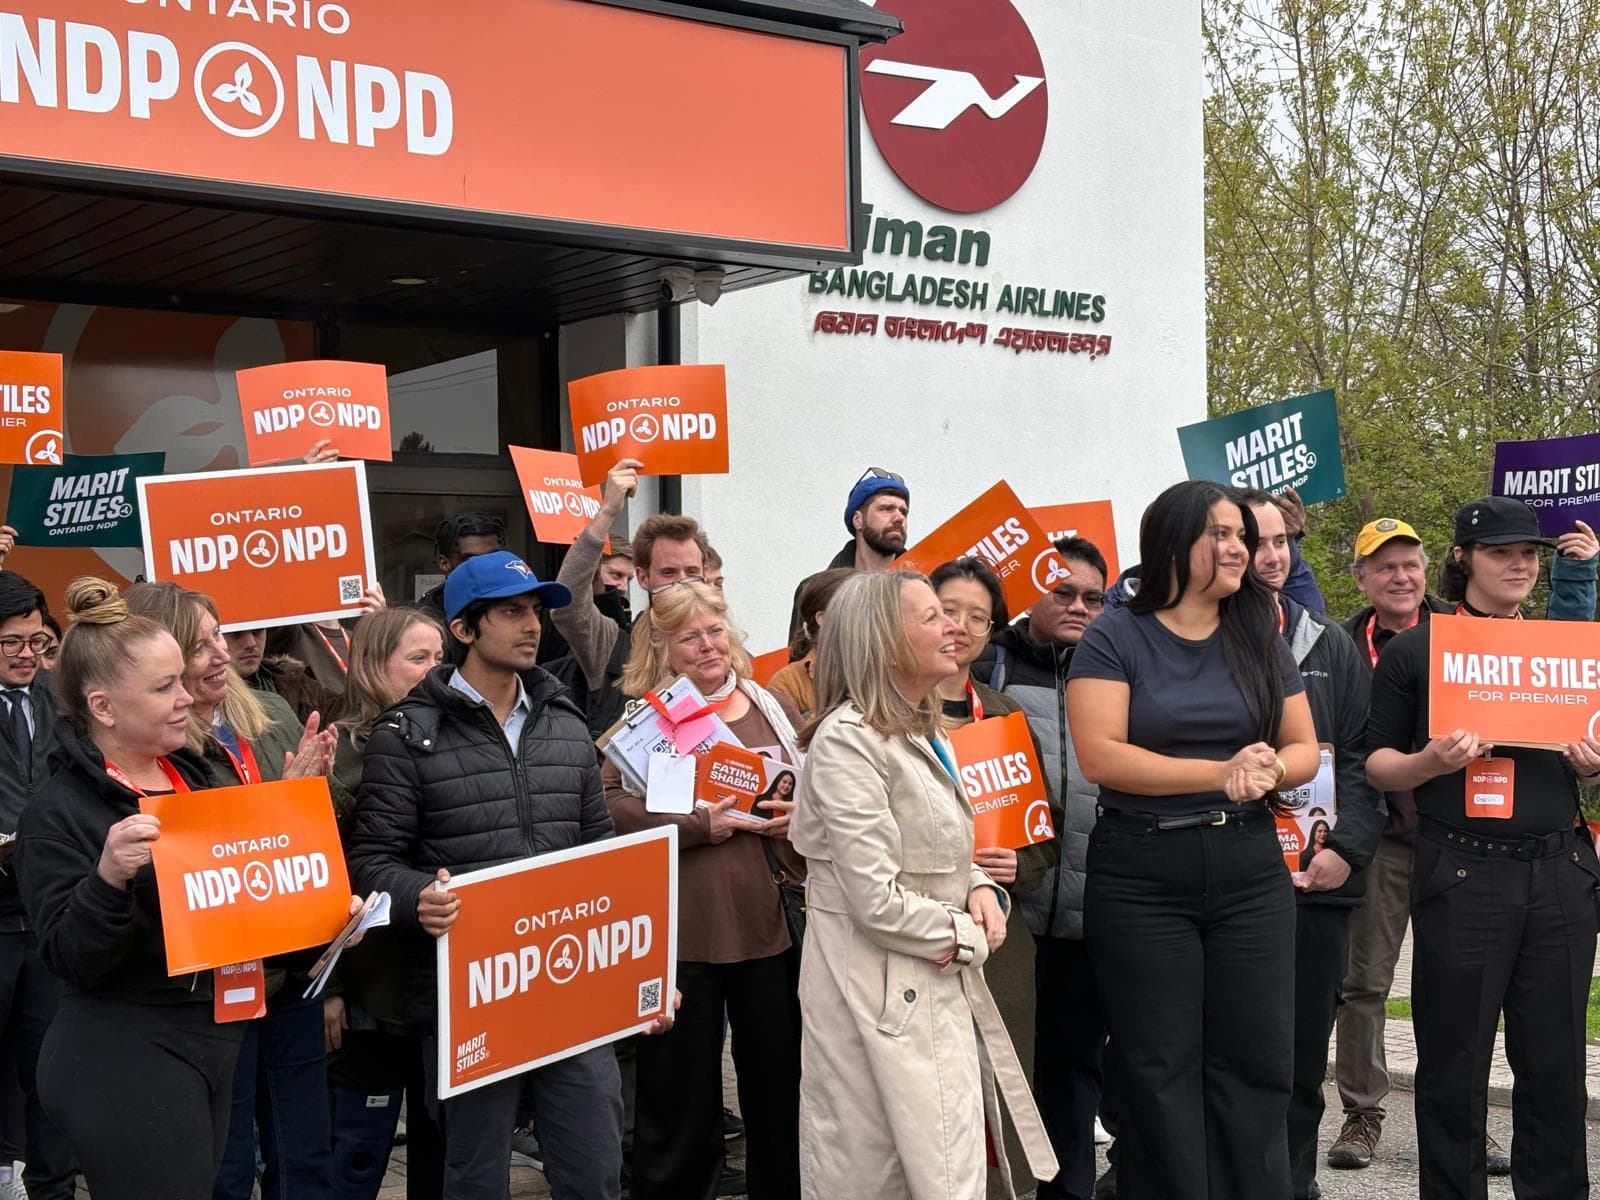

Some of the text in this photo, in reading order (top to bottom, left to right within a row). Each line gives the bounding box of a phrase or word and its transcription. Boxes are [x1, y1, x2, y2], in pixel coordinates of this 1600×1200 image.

[124, 0, 350, 34] ARIO
[0, 12, 454, 156] NDP NPD
[861, 202, 991, 267] iman
[808, 267, 1106, 323] BANGLADESH AIRLINES
[814, 311, 879, 336] বিমান
[885, 316, 988, 345] বাংলাদেশ
[0, 384, 50, 414] ILES
[283, 387, 352, 400] ONTARIO
[606, 396, 681, 413] ONTARIO
[254, 403, 382, 435] NDP NPD
[582, 413, 717, 454] NDP NPD
[1225, 411, 1303, 471] MARIT
[1231, 443, 1309, 490] STILES
[1292, 475, 1309, 489] NDP
[1503, 463, 1600, 496] MARIT STI
[49, 467, 130, 501] MARIT
[1558, 492, 1600, 507] PREMIE
[43, 495, 125, 527] STILES
[210, 506, 303, 526] ONTARIO
[528, 490, 563, 516] NDP
[49, 521, 118, 536] ONTARIO NDP
[957, 517, 1029, 567] ILES
[169, 523, 348, 575] NDP NPD
[1443, 652, 1600, 690] MARIT STILE
[1468, 690, 1588, 705] FOR PREMIER
[709, 770, 759, 792] SHABAN
[712, 762, 760, 783] FATIMA
[961, 752, 1032, 798] STILES
[971, 793, 1020, 815] EMIER
[212, 834, 290, 858] ONTARIO
[183, 852, 329, 912] NDP NPD
[514, 895, 611, 936] ONTARIO
[468, 914, 653, 1009] NDP NPD
[456, 1046, 487, 1073] STILES
[457, 1031, 487, 1060] MARIT
